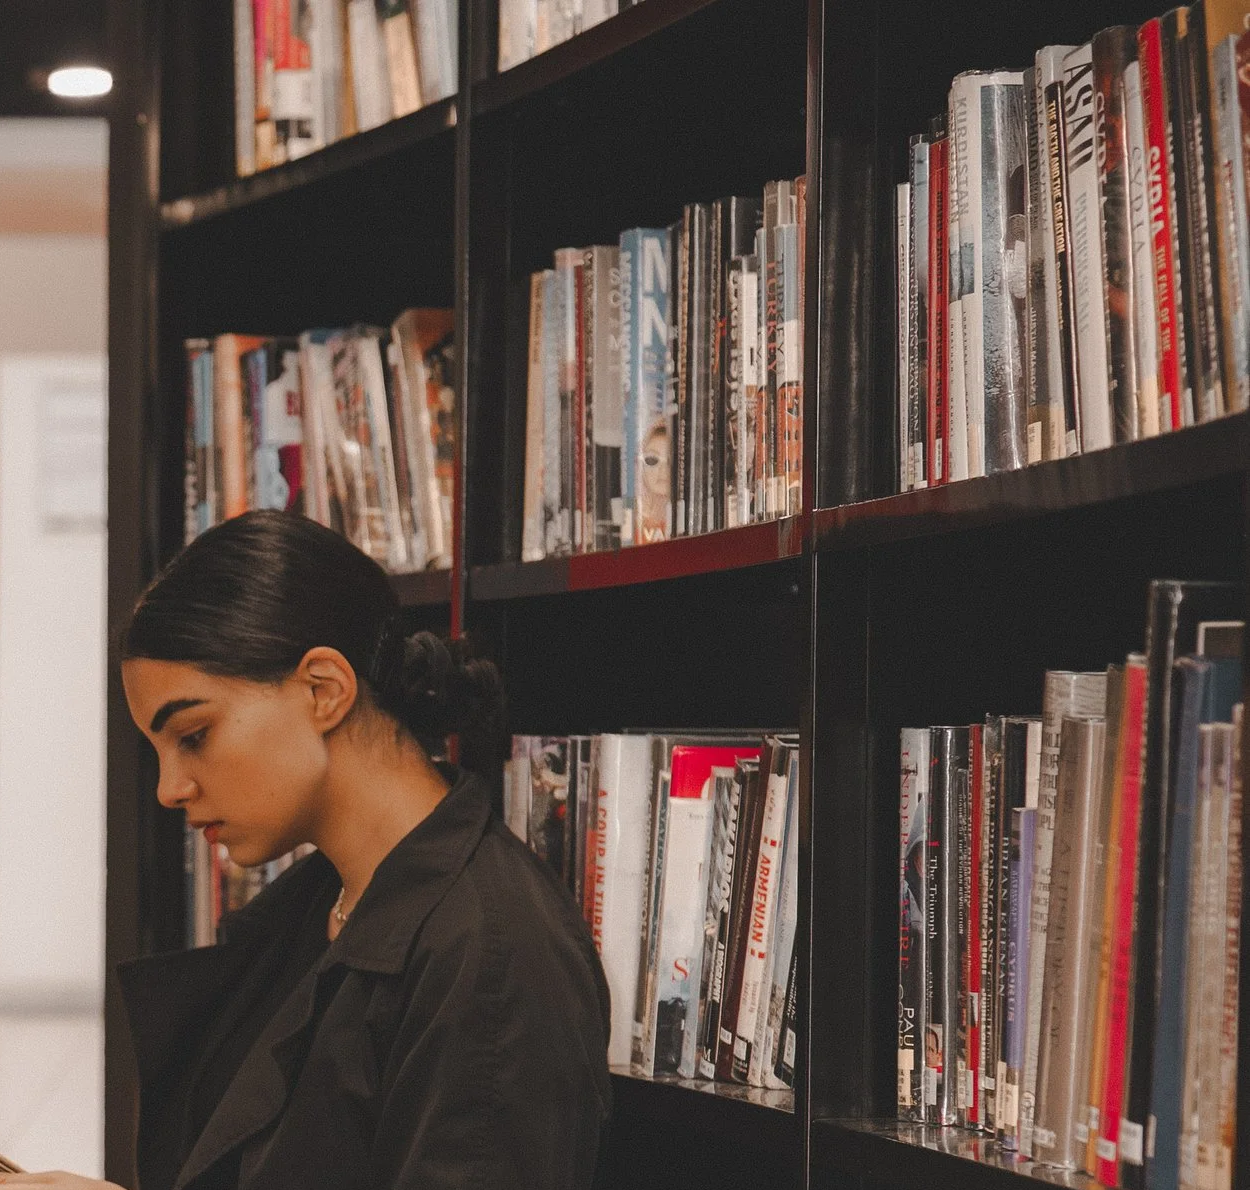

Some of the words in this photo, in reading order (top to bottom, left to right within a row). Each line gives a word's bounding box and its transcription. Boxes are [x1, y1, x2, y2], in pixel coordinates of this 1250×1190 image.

[1029, 88, 1039, 172] BAGHDAD
[1047, 100, 1056, 121] THE
[1063, 62, 1094, 175] ASAD
[956, 96, 969, 216] KURDISTAN
[1050, 156, 1059, 177] AND
[1052, 178, 1061, 199] THE
[1146, 144, 1165, 240] SYRIA
[1053, 201, 1065, 256] CREATION
[1155, 244, 1166, 271] THE
[776, 253, 785, 354] TURKEY
[1157, 274, 1168, 303] FALL
[1160, 307, 1169, 323] OF
[766, 259, 779, 373] TURKEY
[1161, 326, 1171, 351] THE
[598, 789, 609, 798] A
[598, 807, 608, 857] COUP
[718, 779, 741, 914] MAKARIOS
[596, 865, 606, 885] IN
[929, 856, 938, 881] The
[1001, 837, 1009, 902] BRIAN
[751, 854, 771, 943] ARMENIAN
[928, 883, 938, 940] Triumph
[712, 951, 725, 1004] BIOGRAPHY
[998, 911, 1008, 998] KEENAN
[1007, 941, 1017, 1022] CYPRUS
[903, 1007, 915, 1049] PAU
